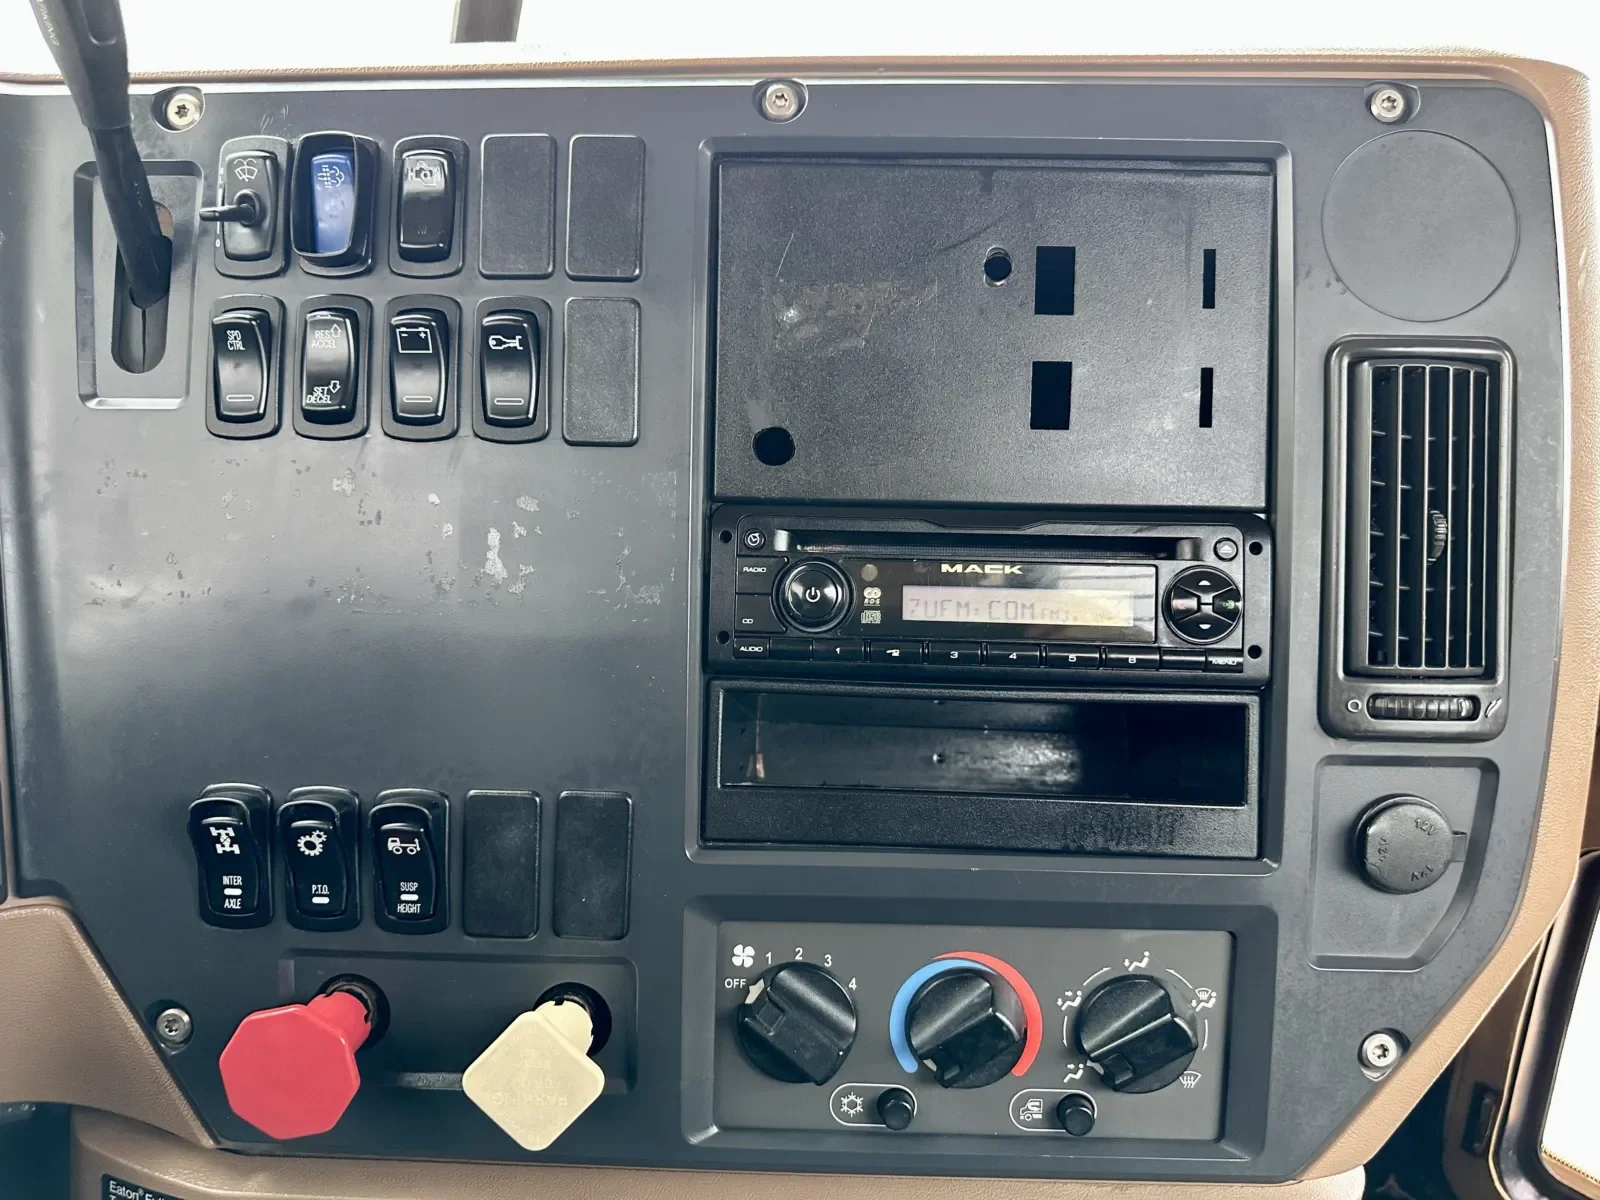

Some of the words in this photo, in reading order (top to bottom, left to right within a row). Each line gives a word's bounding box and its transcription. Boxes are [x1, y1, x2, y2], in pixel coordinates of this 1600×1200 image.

[226, 330, 242, 341] SPD
[227, 340, 246, 351] CTRL
[311, 339, 338, 349] ACCEL
[313, 386, 330, 396] SET
[306, 394, 333, 404] DECEL
[941, 563, 1023, 575] MACK
[739, 645, 764, 653] AUDIO
[835, 647, 841, 655] 1
[950, 651, 959, 659] 3
[1008, 652, 1018, 660] 4
[1068, 654, 1077, 662] 5
[1414, 815, 1439, 836] 12V
[222, 875, 243, 886] INTER
[400, 881, 419, 892] SUSP
[223, 898, 242, 909] AXLE
[397, 903, 422, 914] HEIGHT
[765, 951, 772, 965] 1
[795, 947, 804, 960] 2
[824, 954, 833, 967] 3
[724, 978, 747, 989] OFF
[848, 977, 857, 990] 4
